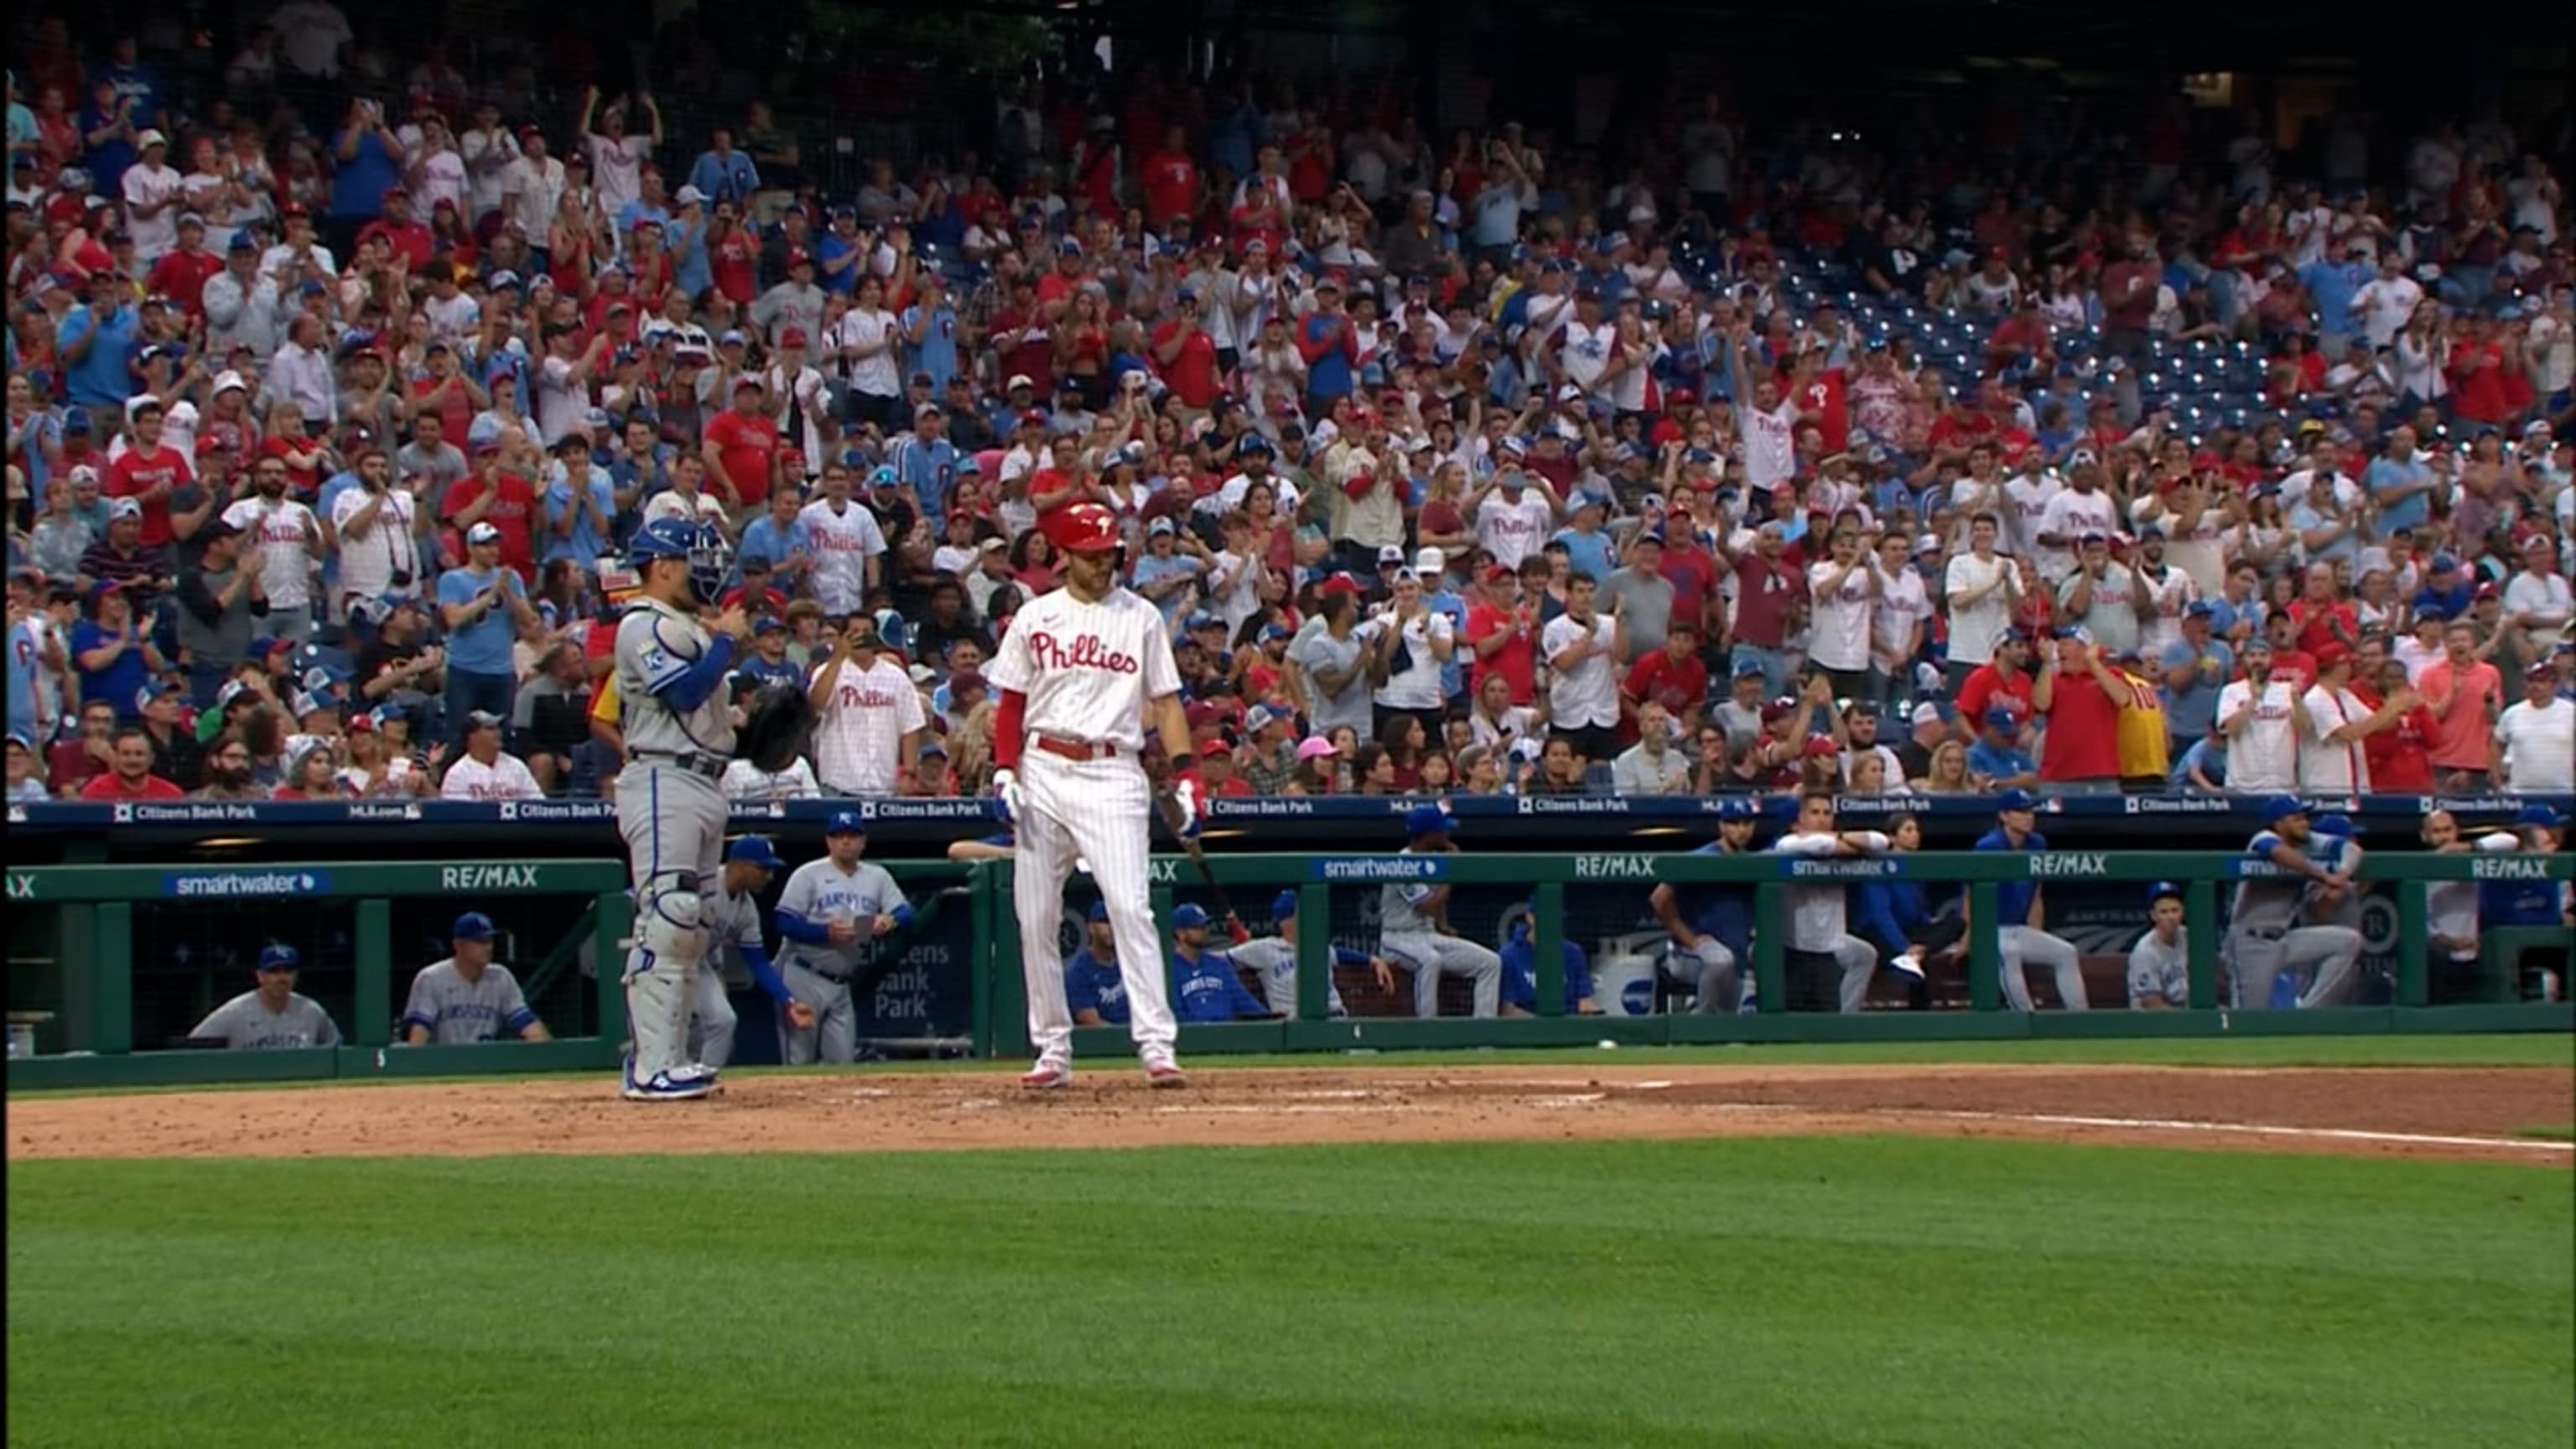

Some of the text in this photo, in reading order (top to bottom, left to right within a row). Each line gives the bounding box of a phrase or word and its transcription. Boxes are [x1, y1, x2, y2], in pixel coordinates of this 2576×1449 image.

[1030, 631, 1138, 674] Phillies
[137, 805, 256, 819] Citizens Bank Park
[521, 803, 569, 818] Citizens
[572, 803, 601, 817] Bank
[880, 803, 982, 817] Citizens Bank Park
[1216, 801, 1313, 813] Citizens Bank Park
[1325, 859, 1421, 878] smartwater
[1575, 857, 1655, 876] RE/MAX
[2030, 854, 2106, 875] RE/MAX
[2473, 860, 2547, 878] RE/MAX
[177, 874, 297, 895] smartwater
[443, 866, 538, 889] RE/MAX
[876, 966, 929, 991] ank
[875, 995, 927, 1018] Park
